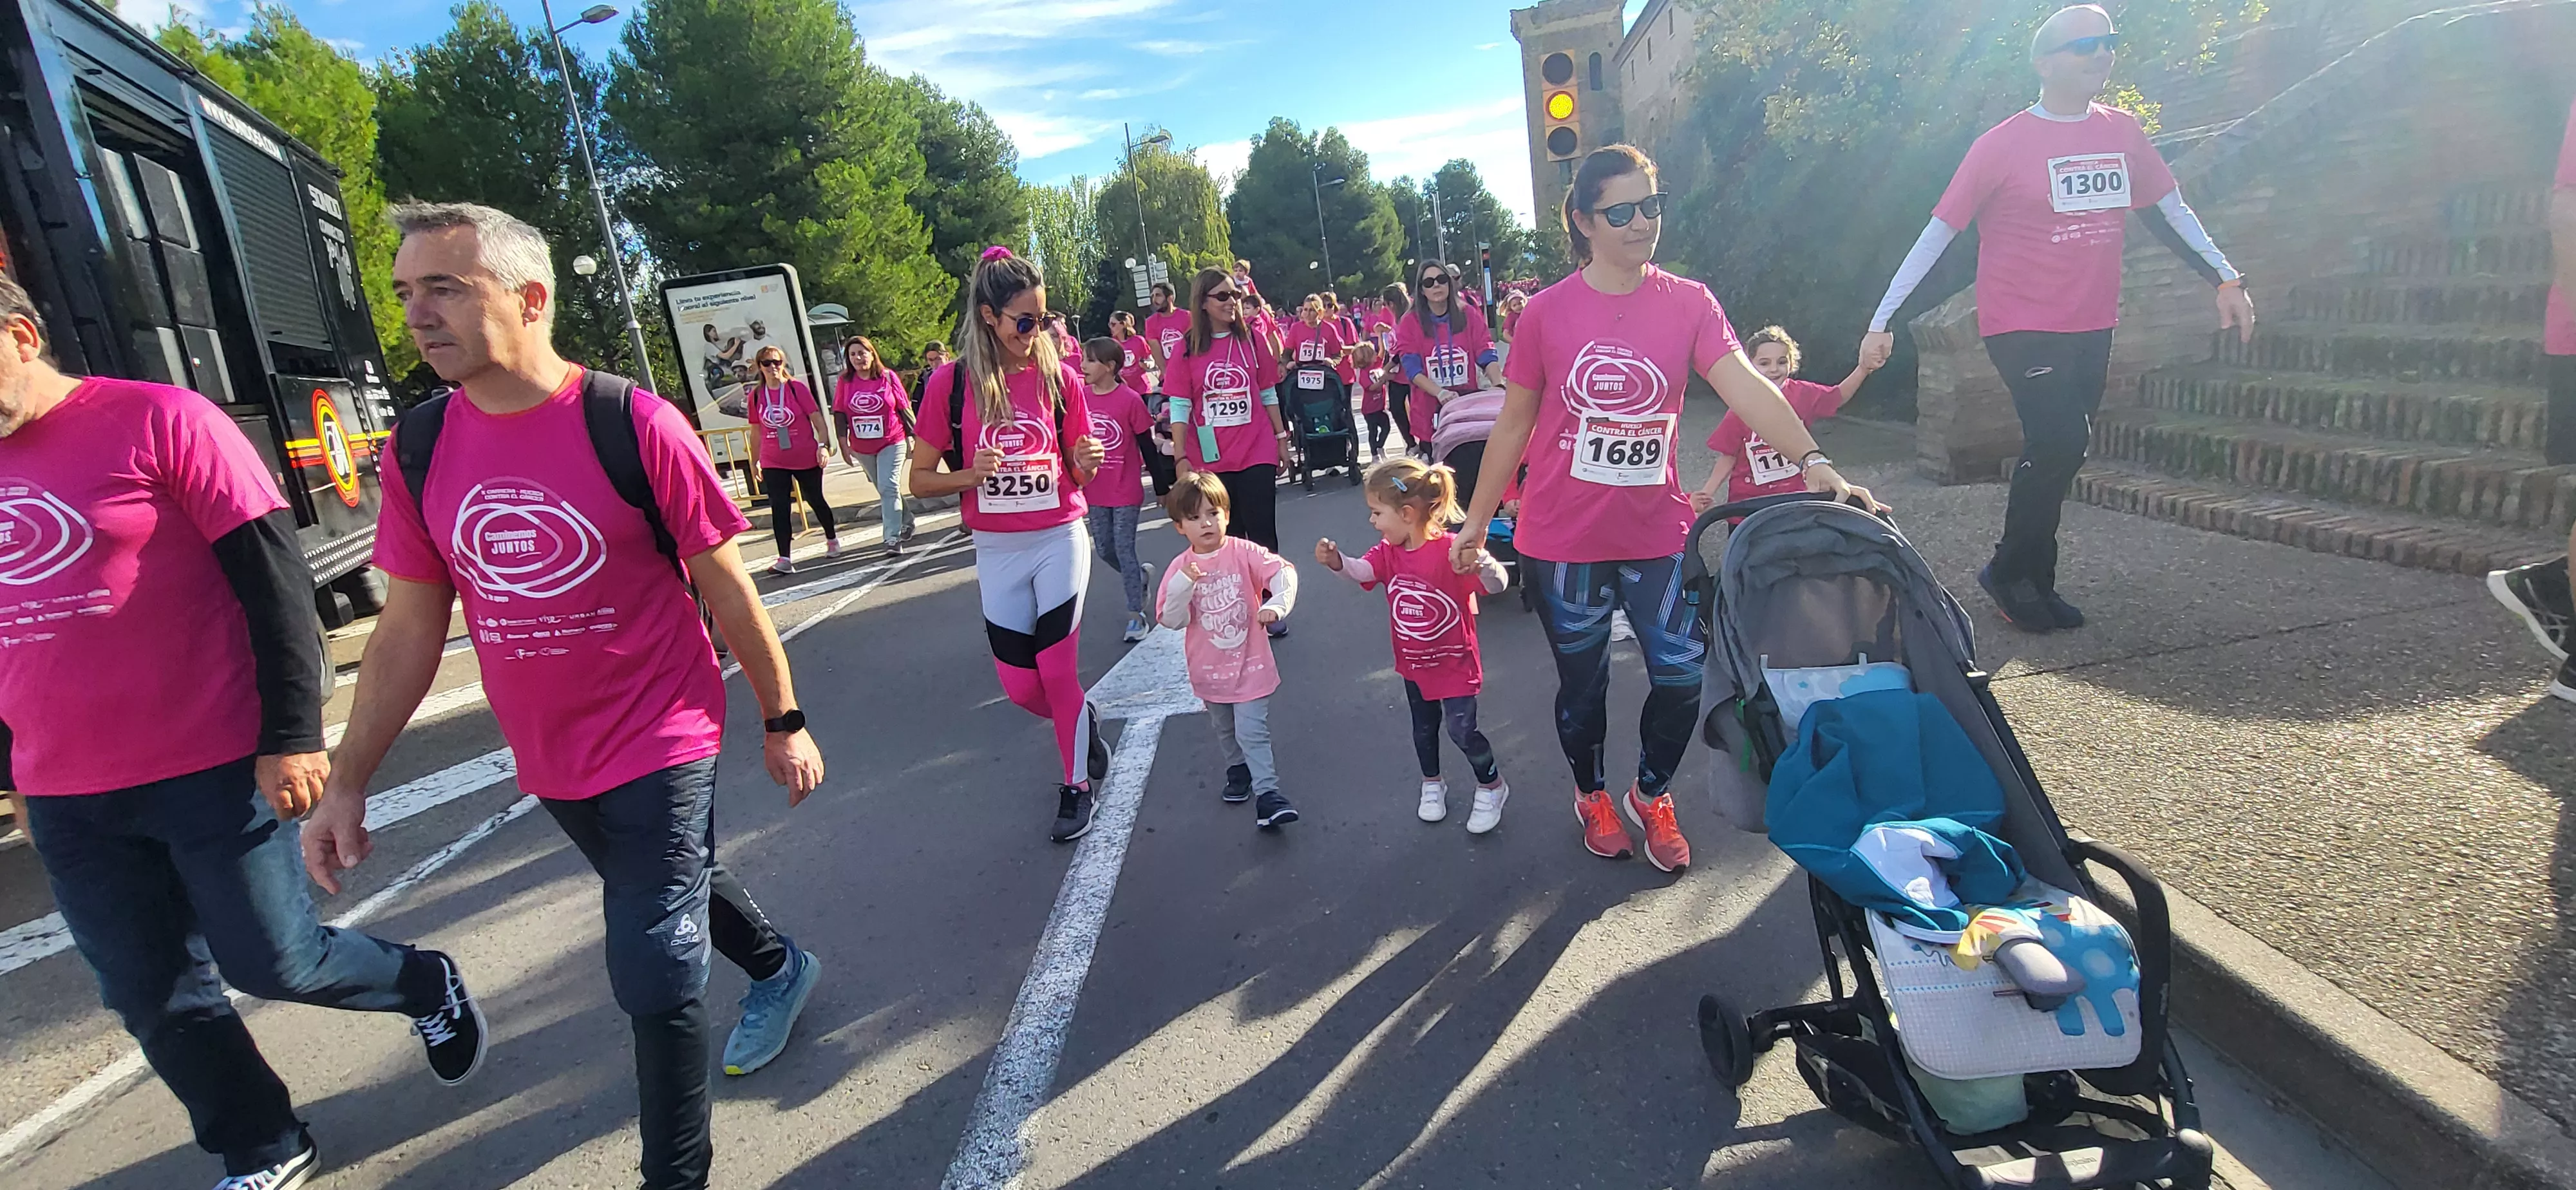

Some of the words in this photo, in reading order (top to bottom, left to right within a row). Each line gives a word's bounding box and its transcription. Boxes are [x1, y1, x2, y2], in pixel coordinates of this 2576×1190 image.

[2061, 171, 2122, 195] 1300
[1594, 381, 1623, 391] JUNTOS
[1209, 400, 1247, 417] 1299
[856, 424, 880, 433] 1774
[1591, 424, 1626, 436] CONTRA
[1638, 426, 1662, 436] CÁNCER
[1587, 437, 1661, 466] 1689
[1757, 453, 1792, 469] 11
[987, 474, 1050, 496] 3250
[491, 540, 536, 554] JUNTOS
